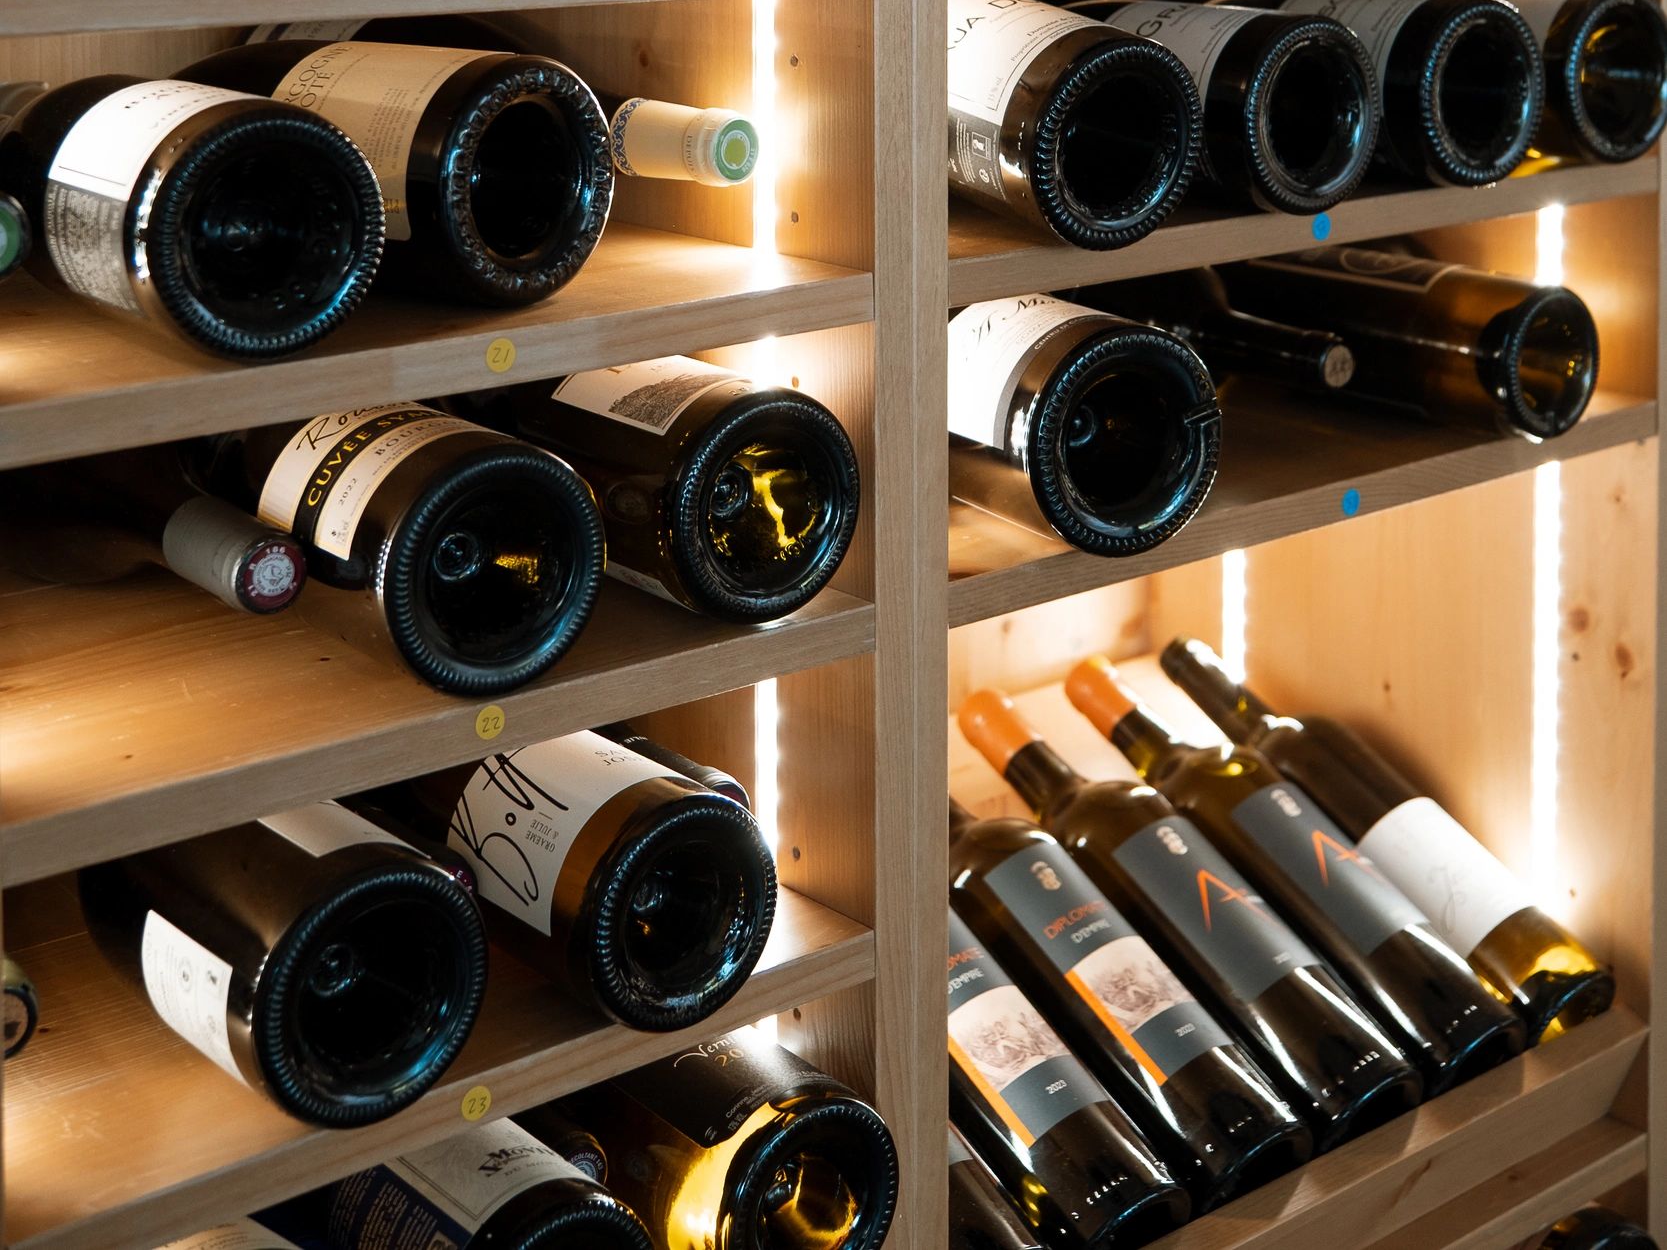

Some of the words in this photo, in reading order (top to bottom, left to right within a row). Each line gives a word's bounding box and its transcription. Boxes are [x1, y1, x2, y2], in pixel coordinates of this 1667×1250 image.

[492, 346, 511, 364] 21
[307, 429, 372, 507] CUVÉE
[481, 716, 501, 734] 22
[530, 818, 551, 836] JULIE
[524, 829, 556, 853] GRAEME
[467, 1095, 487, 1114] 23
